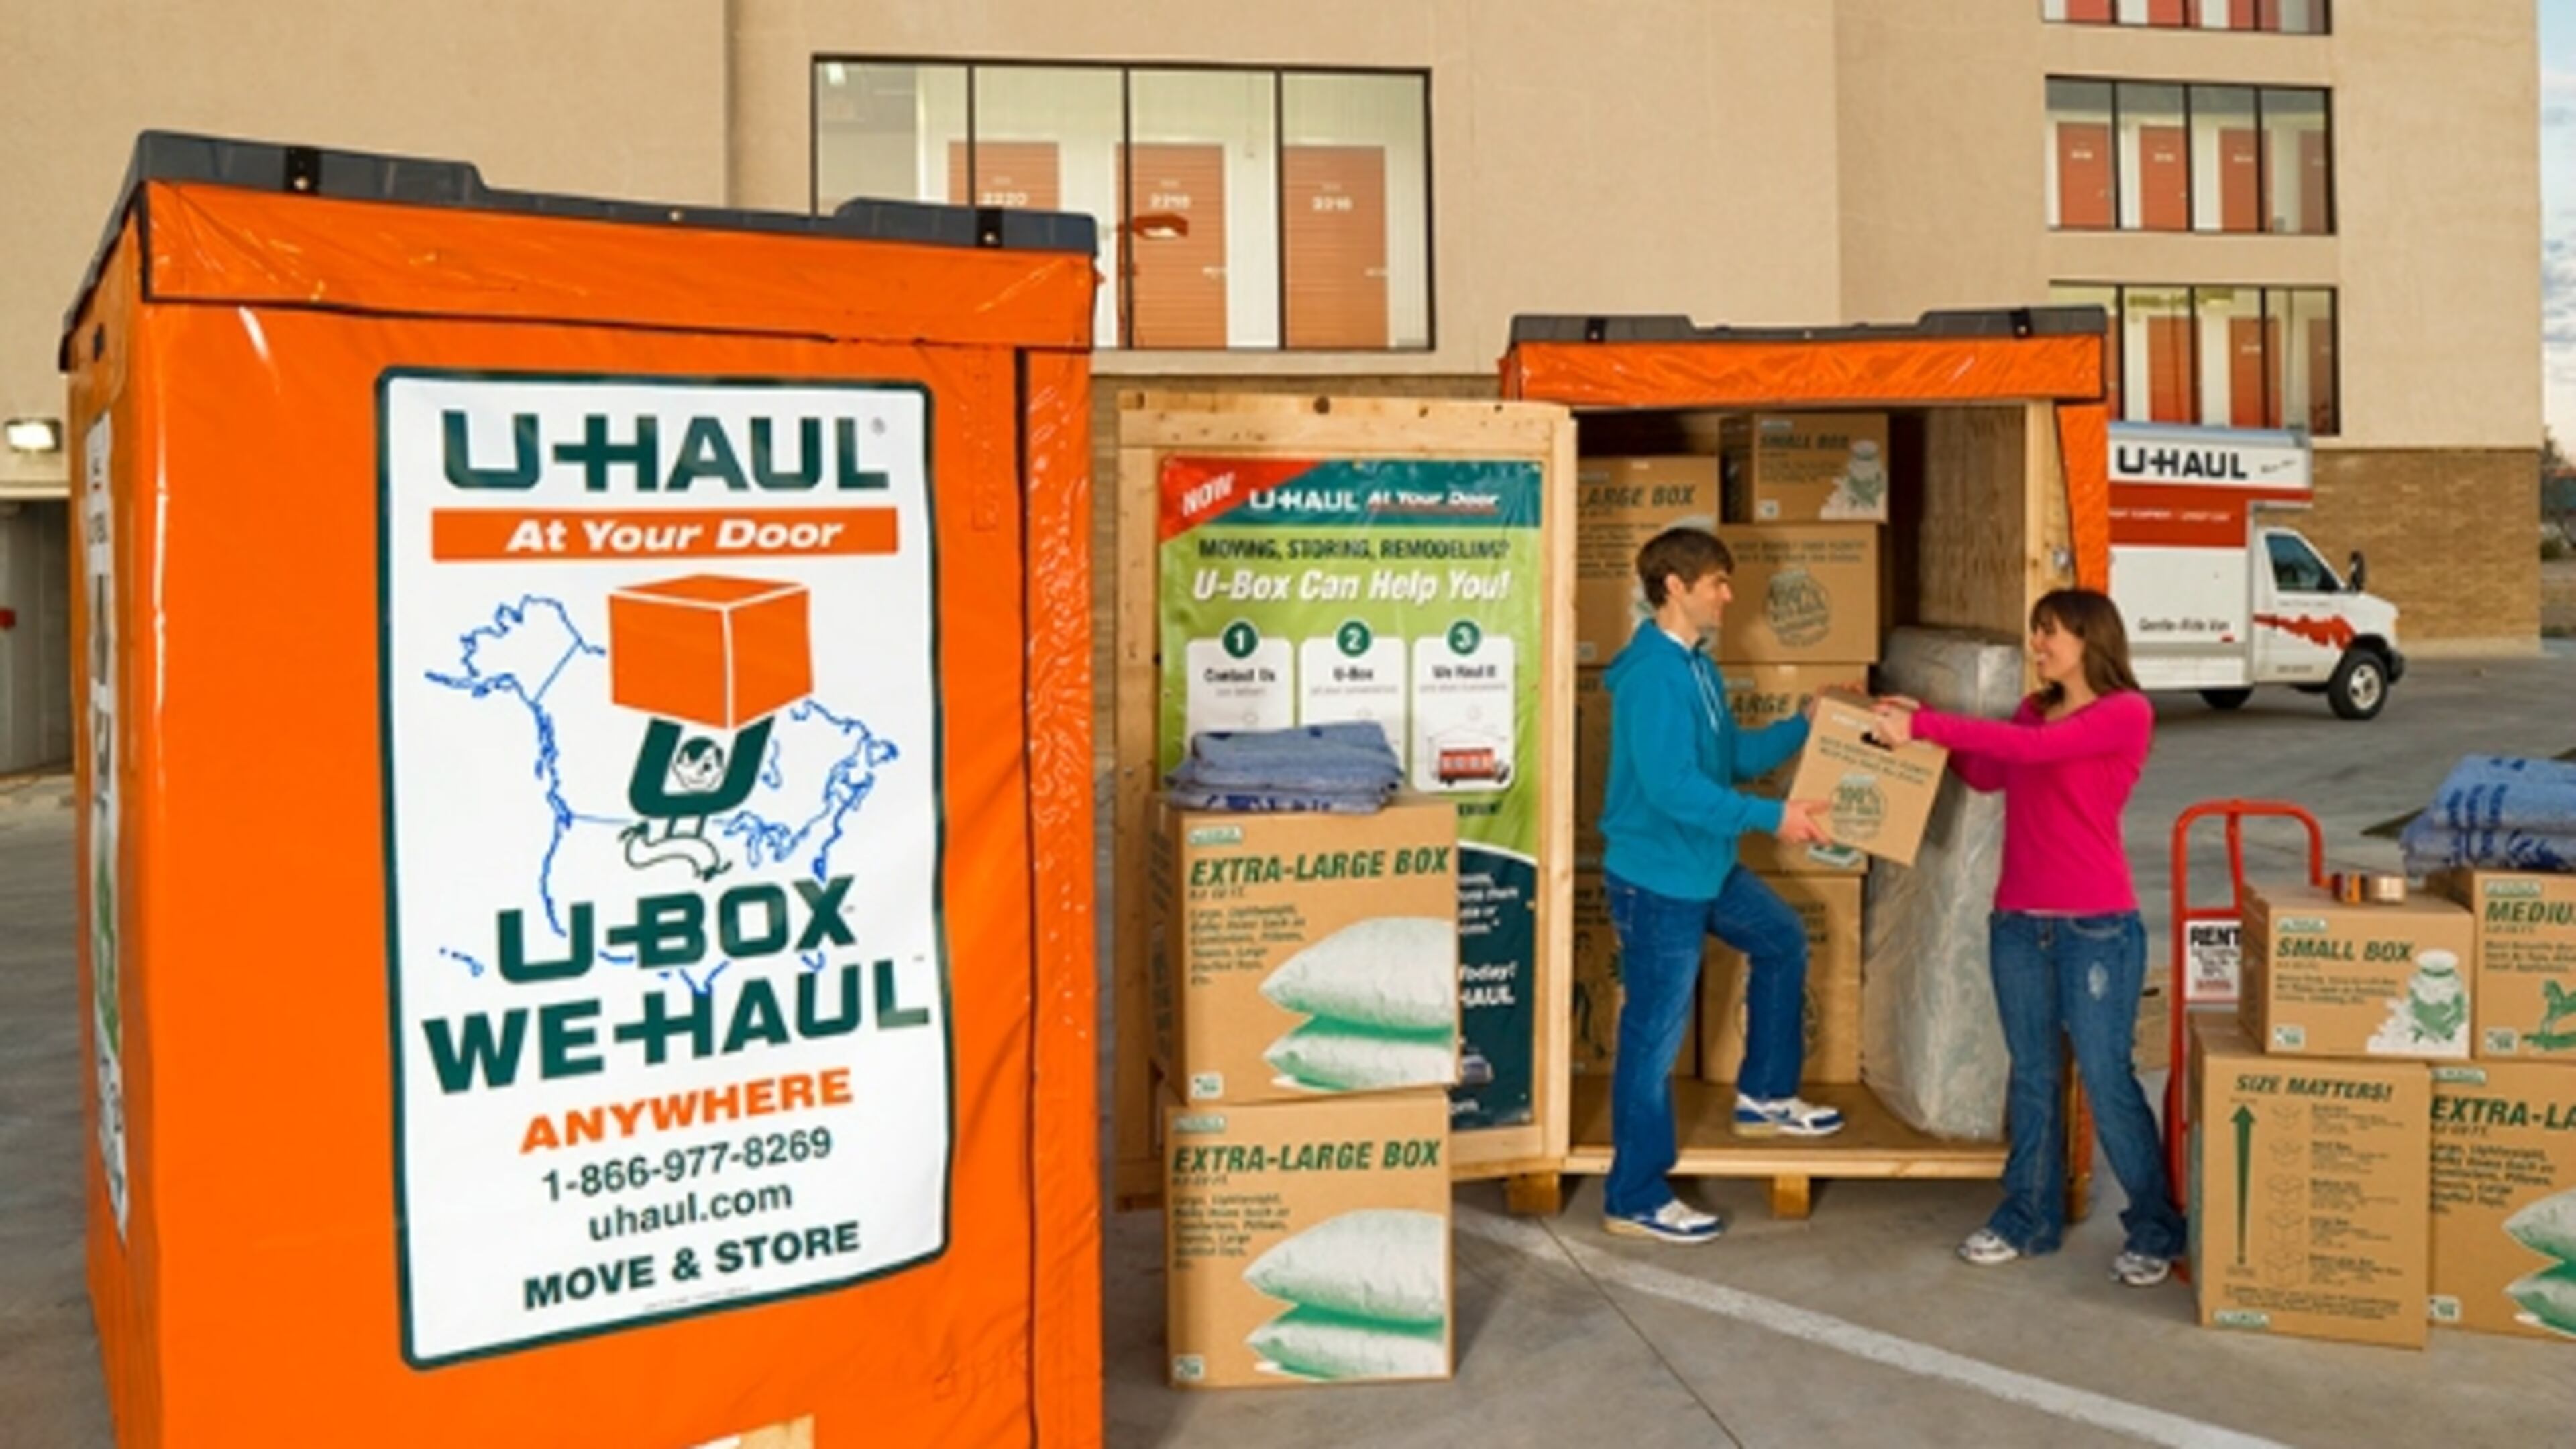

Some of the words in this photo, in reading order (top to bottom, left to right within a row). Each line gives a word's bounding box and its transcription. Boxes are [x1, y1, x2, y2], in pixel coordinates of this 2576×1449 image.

[442, 410, 889, 491] U-HAUL
[2117, 446, 2247, 479] U-HAUL
[1182, 472, 1236, 517] NOW
[1248, 489, 1360, 512] U-HAUL
[1652, 484, 1696, 508] BOX
[506, 519, 566, 551] At
[582, 519, 702, 551] Your
[717, 519, 843, 549] Door
[1198, 537, 1283, 560] MOVING,
[1287, 539, 1375, 561] STORING,
[1193, 568, 1291, 600] U-Box
[1299, 568, 1360, 600] Can
[1369, 569, 1439, 604] Help
[1448, 568, 1512, 600] You!
[1234, 631, 1246, 650] 1
[1346, 629, 1361, 649] 2
[1456, 628, 1472, 648] 3
[1189, 850, 1384, 888] EXTRA-LARGE
[1395, 847, 1450, 875] BOX
[497, 875, 857, 984] U-BOX
[2485, 900, 2576, 926] MEDIU
[2277, 937, 2357, 961] SMALL
[2363, 941, 2414, 963] BOX
[2235, 1074, 2281, 1095] SIZE
[2284, 1077, 2394, 1103] MATTERS!
[519, 1067, 853, 1155] ANYWHERE
[2431, 1094, 2576, 1131] EXTRA-LA
[541, 1126, 834, 1201] 1-866-977-8269
[1172, 1142, 1373, 1175] EXTRA-LARGE
[1383, 1140, 1440, 1169] BOX
[588, 1181, 794, 1241] uhaul.com
[523, 1255, 655, 1311] MOVE
[672, 1248, 702, 1281] &
[715, 1220, 861, 1274] STORE
